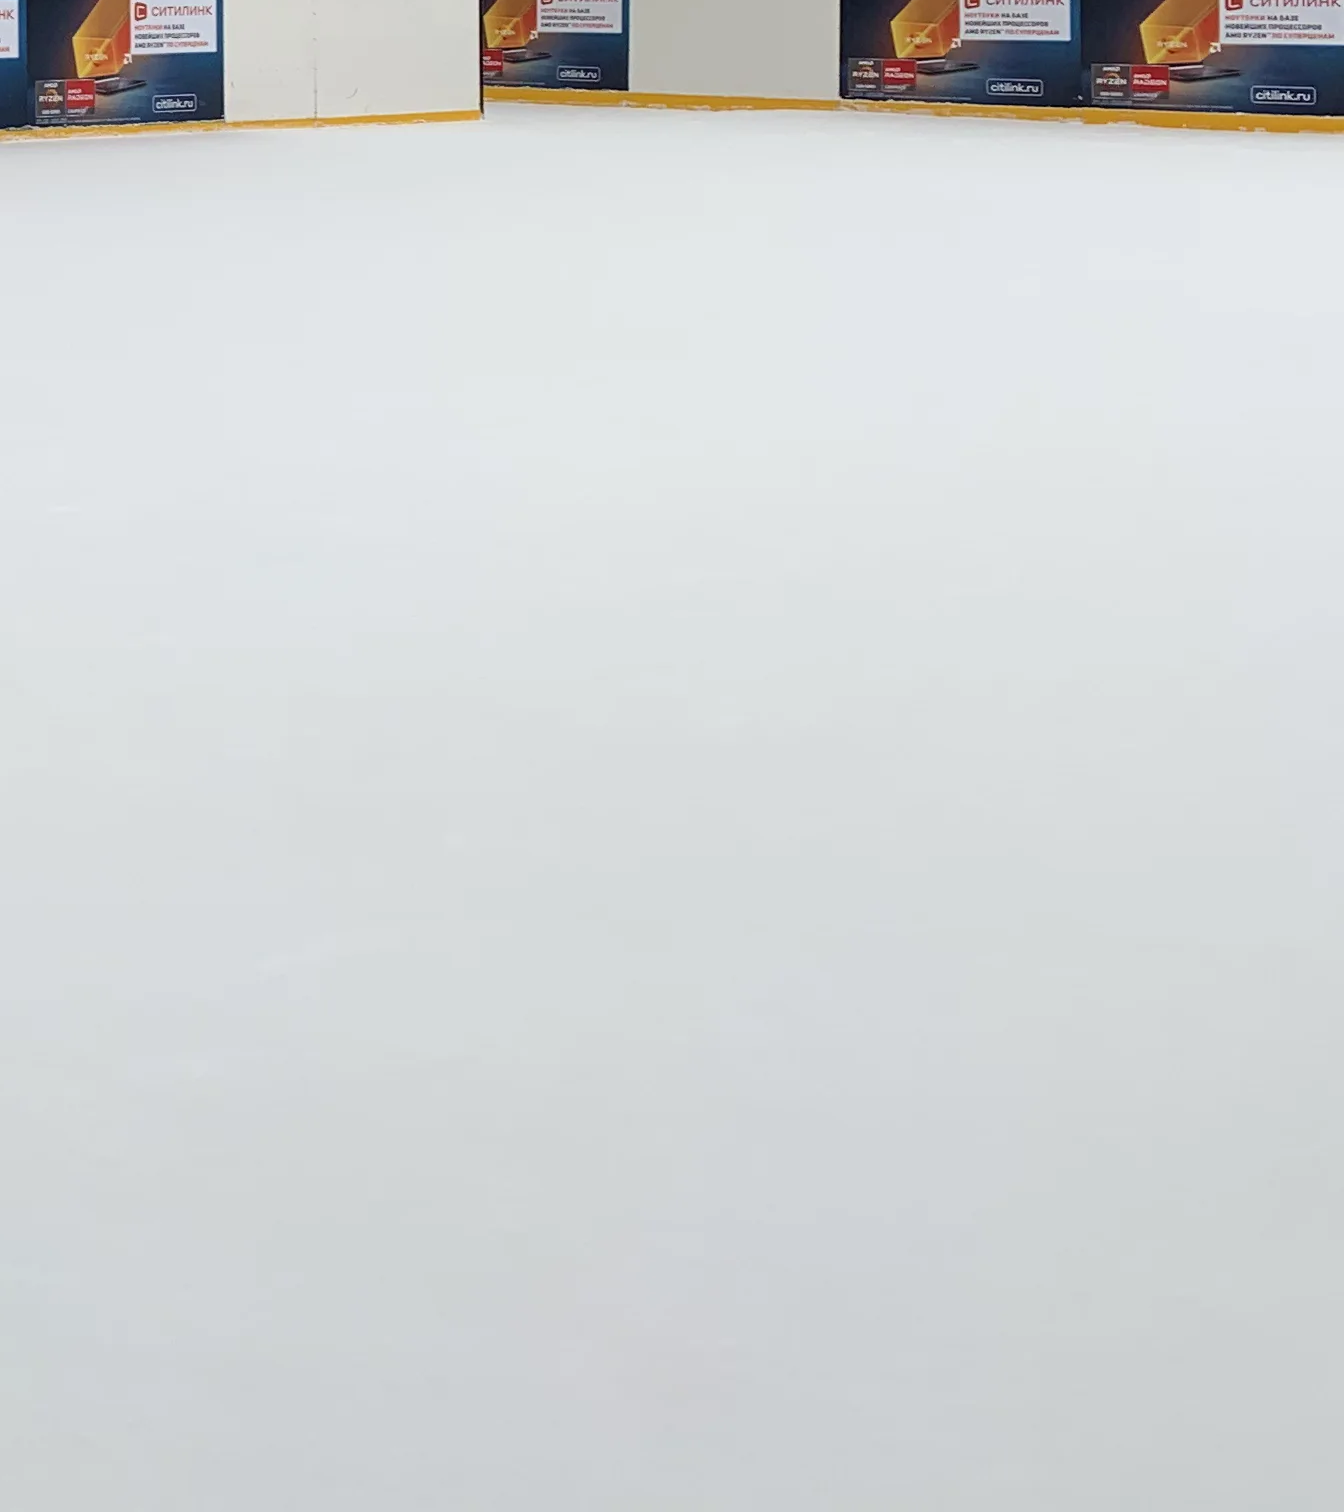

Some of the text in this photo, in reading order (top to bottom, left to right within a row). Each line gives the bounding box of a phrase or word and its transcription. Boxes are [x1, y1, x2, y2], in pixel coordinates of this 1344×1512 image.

[152, 5, 212, 16] СИТИЛИНК
[991, 82, 1038, 93] citilink.ru
[1256, 89, 1310, 101] citilink.ru
